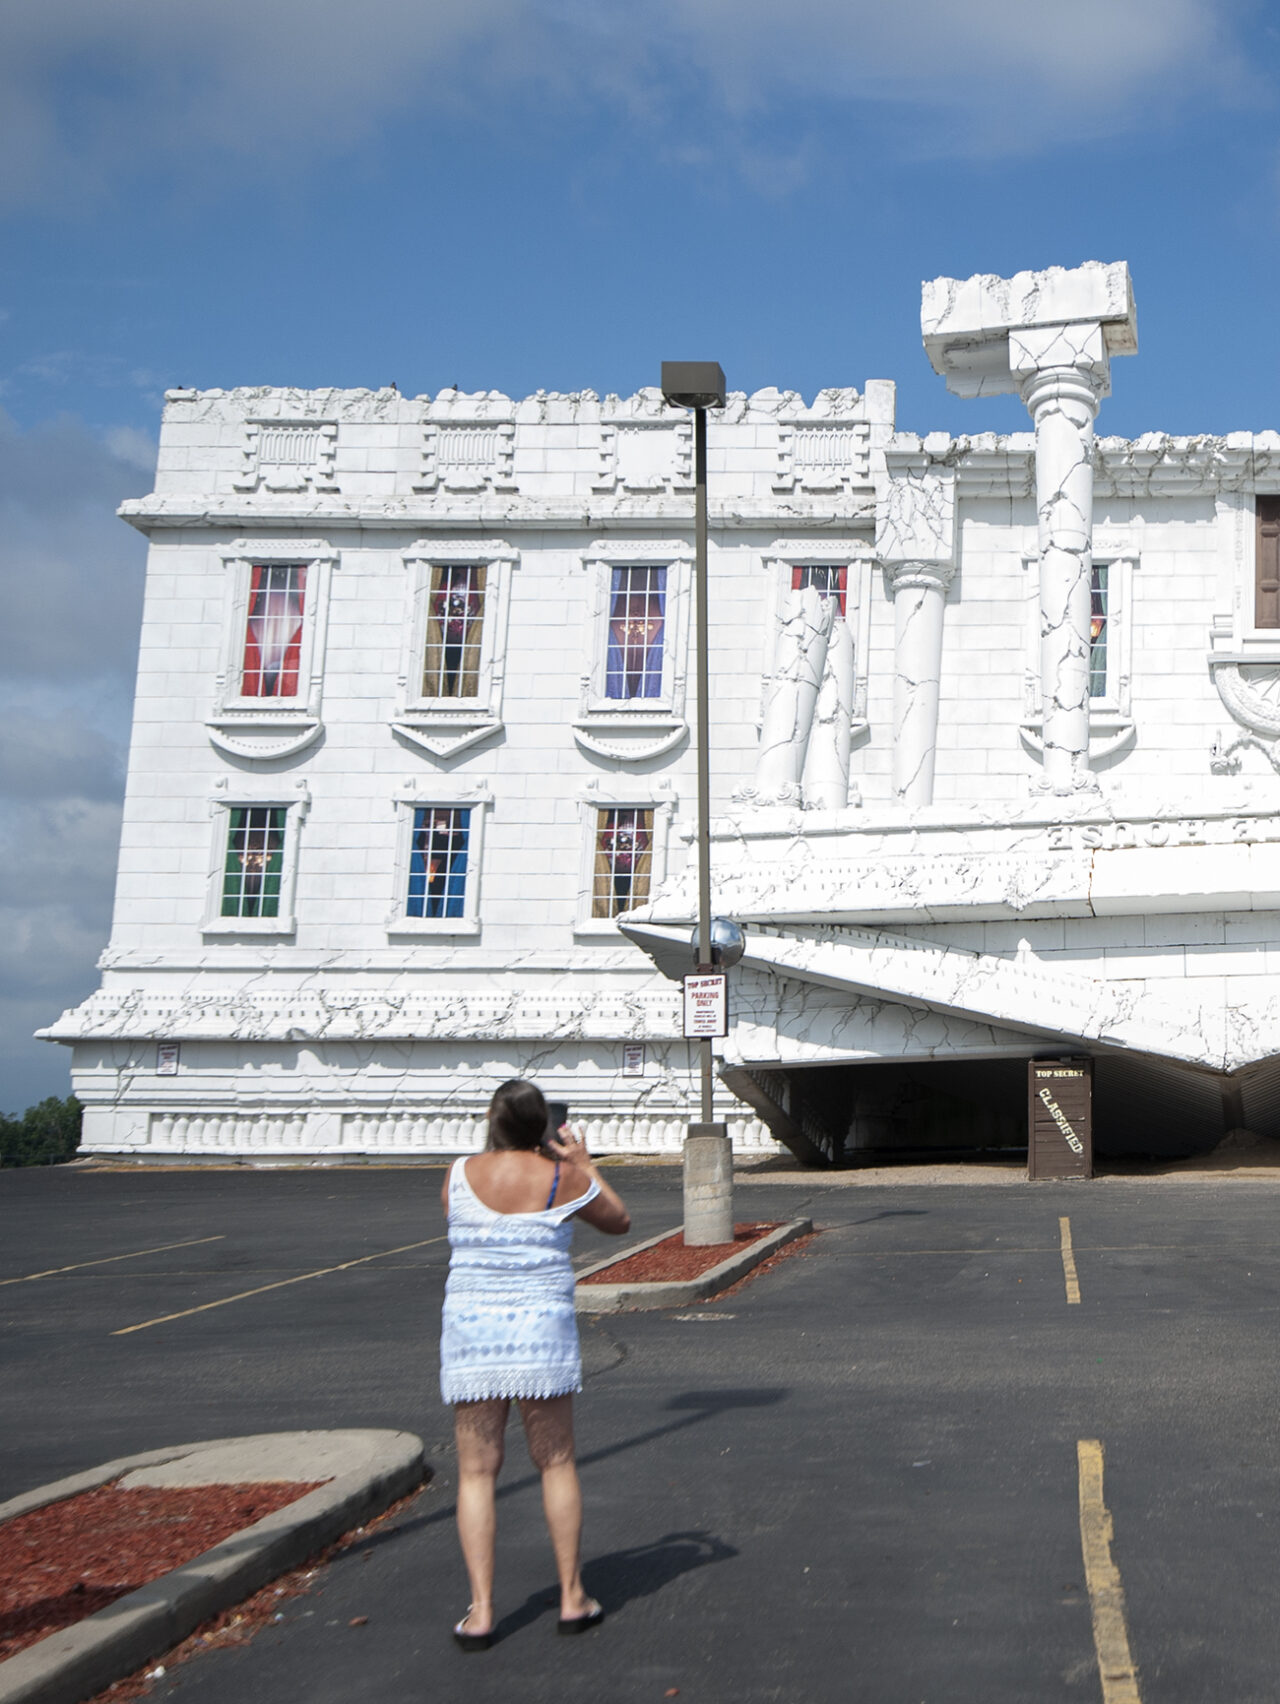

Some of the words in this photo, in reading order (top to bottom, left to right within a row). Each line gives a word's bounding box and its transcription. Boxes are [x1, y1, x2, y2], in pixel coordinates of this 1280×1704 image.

[1047, 817, 1207, 851] HOUSE
[687, 981, 699, 989] TOP
[701, 978, 722, 987] SECRET
[1035, 1070, 1052, 1078] TOP
[1053, 1069, 1084, 1077] SECRET
[1039, 1087, 1084, 1154] CLASSIFIED
